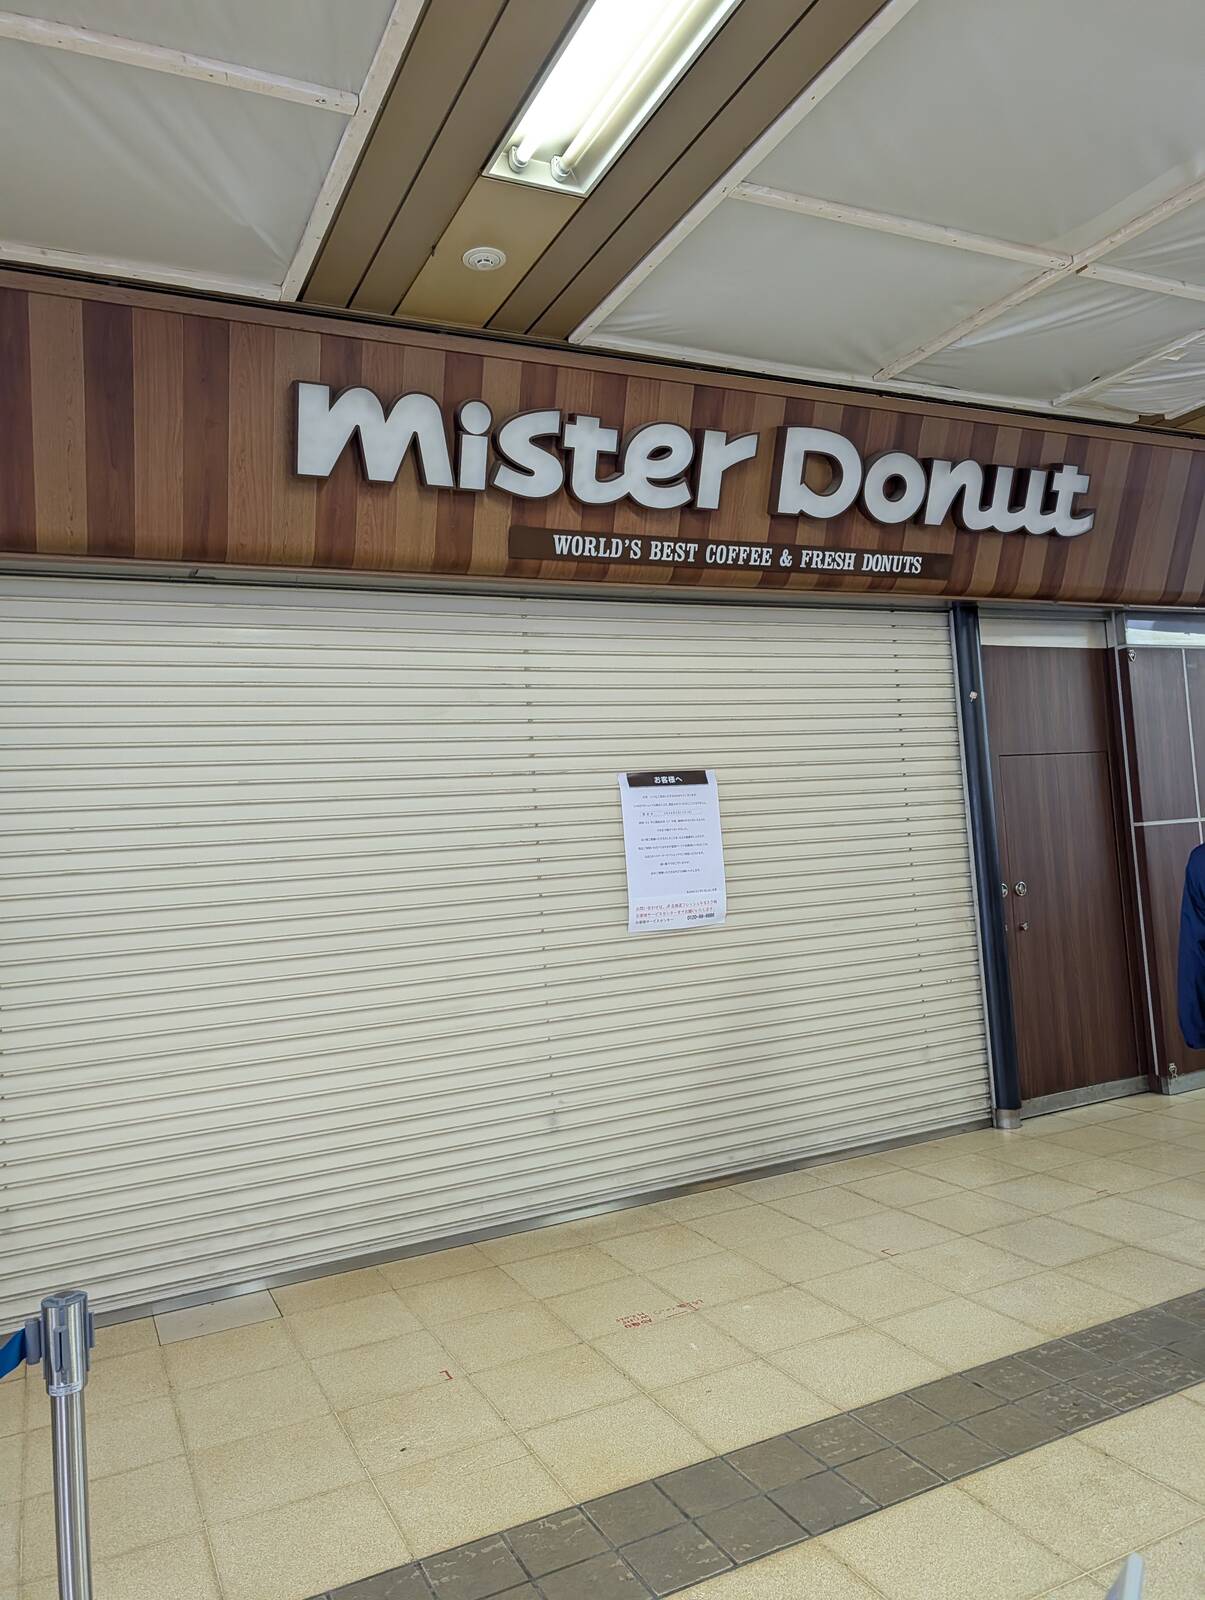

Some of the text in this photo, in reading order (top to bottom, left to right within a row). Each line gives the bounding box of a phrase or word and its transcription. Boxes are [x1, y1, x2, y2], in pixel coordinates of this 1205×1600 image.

[774, 427, 1095, 536] Donut
[553, 534, 923, 575] WORLD'S BEST COFFEE & FRESH DONUTS
[654, 775, 683, 784] お客様へ
